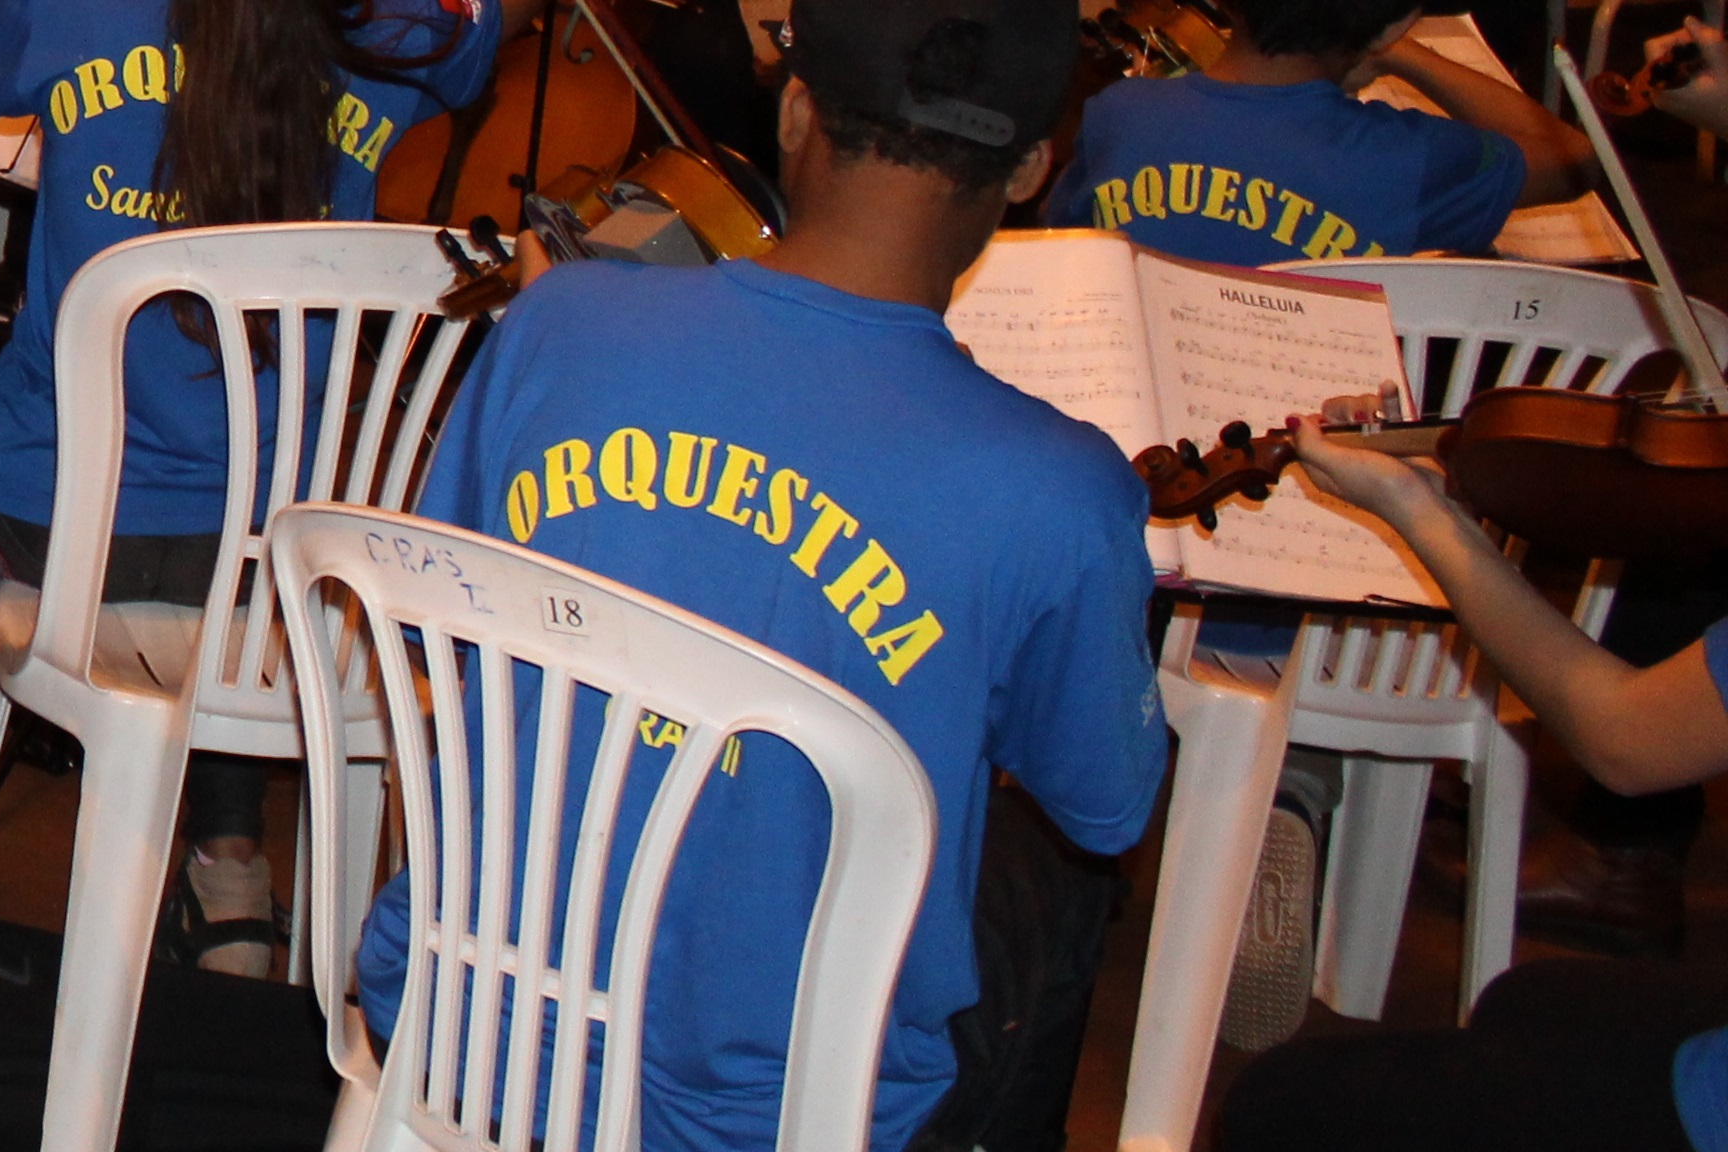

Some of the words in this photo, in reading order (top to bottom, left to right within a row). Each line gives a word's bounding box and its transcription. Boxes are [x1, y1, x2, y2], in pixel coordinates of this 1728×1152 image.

[1094, 162, 1385, 259] RQUESTR
[1219, 287, 1305, 315] HALLELUIA
[1513, 299, 1541, 321] 15
[507, 427, 944, 686] ORQUESTRA
[547, 596, 584, 628] 18
